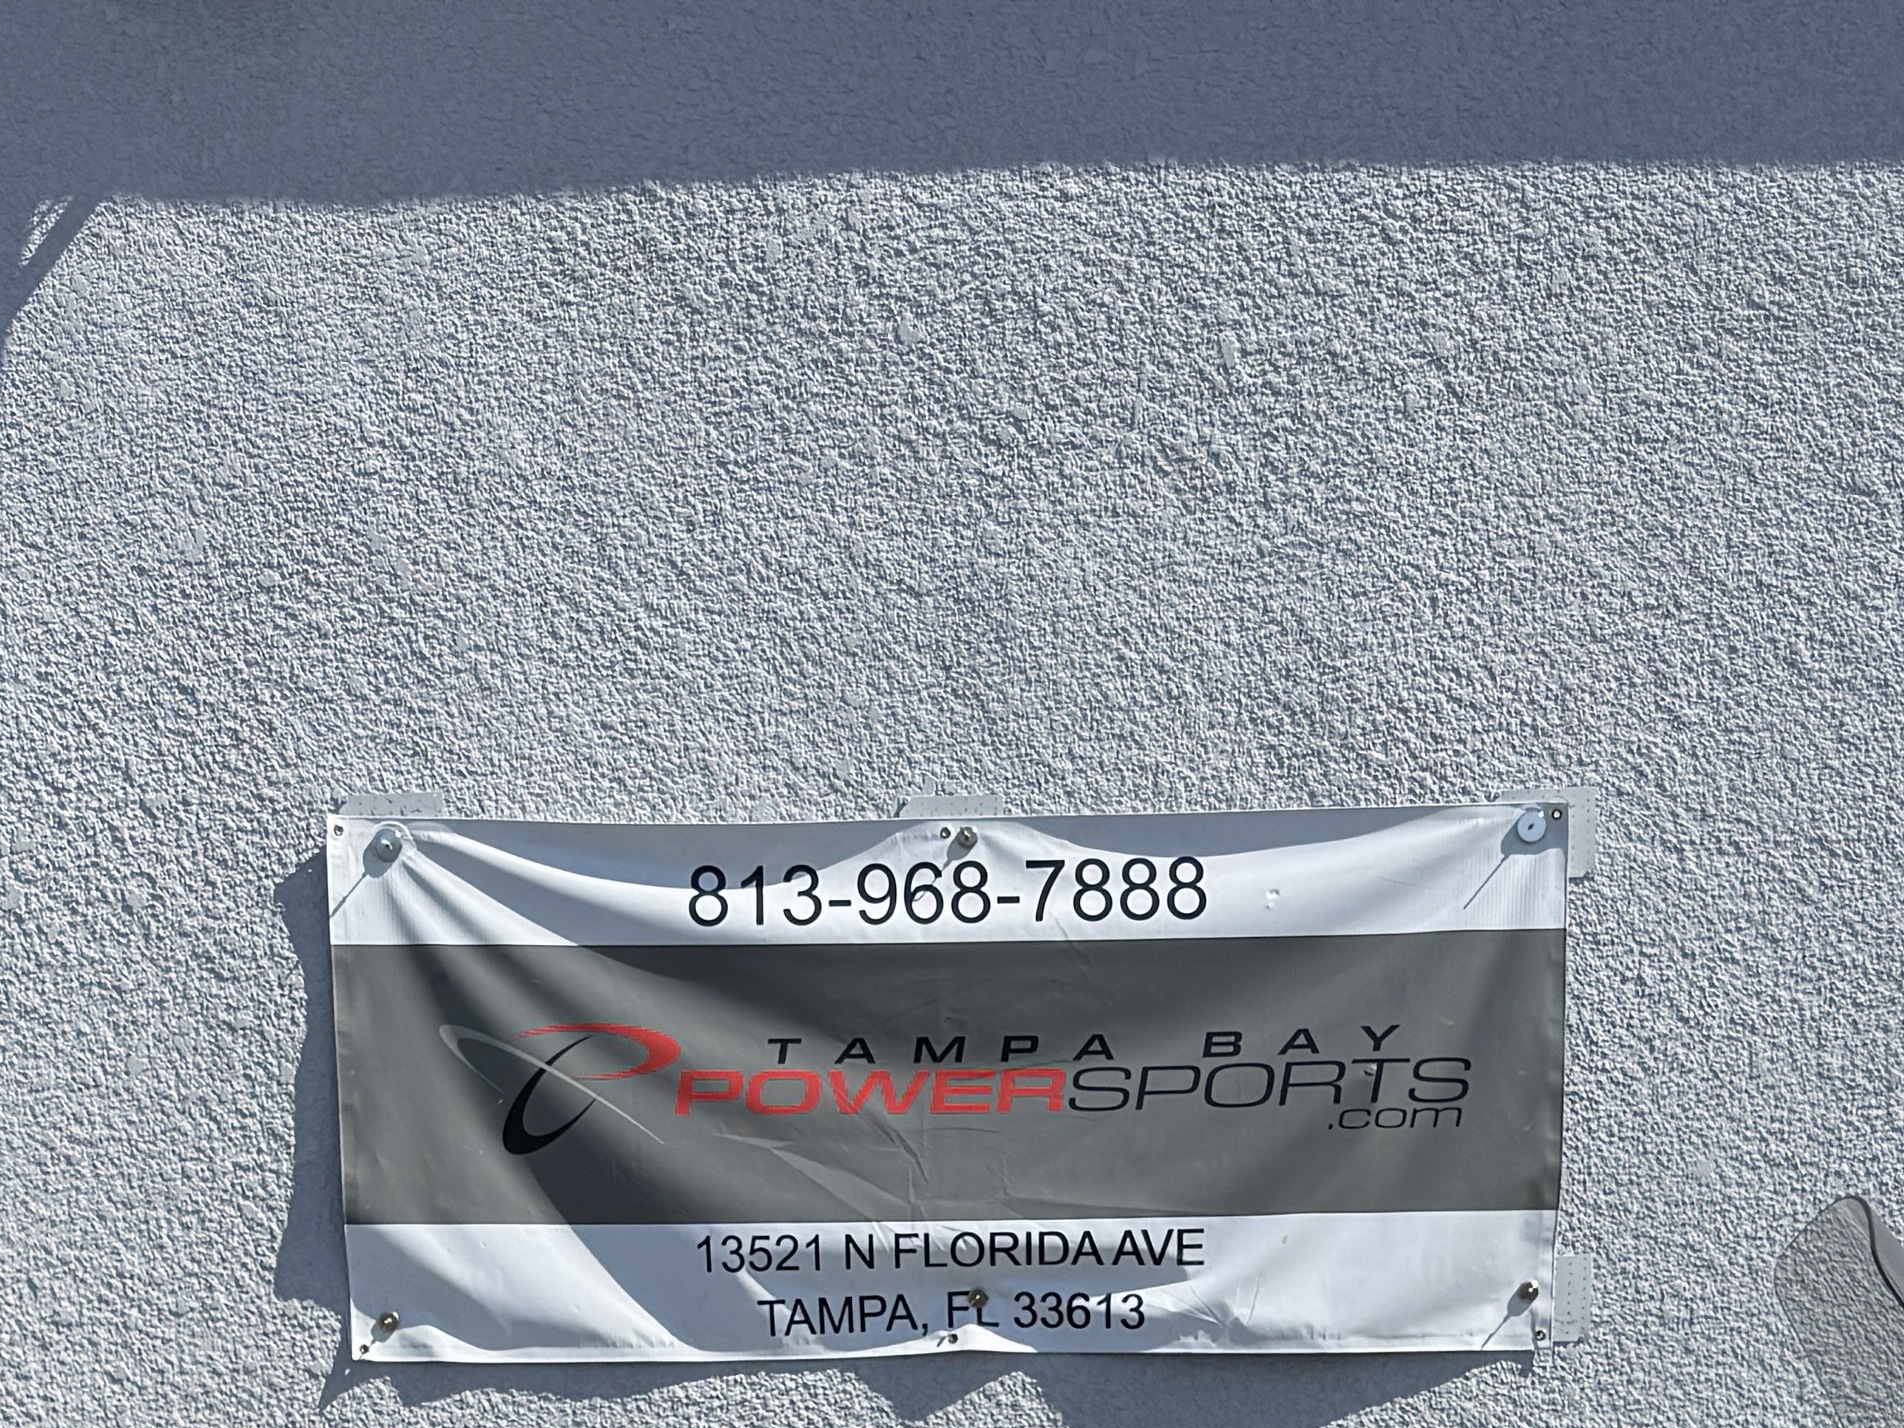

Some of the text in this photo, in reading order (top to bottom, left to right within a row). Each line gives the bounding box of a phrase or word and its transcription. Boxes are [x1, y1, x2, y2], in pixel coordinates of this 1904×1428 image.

[687, 855, 1208, 928] 813-968-7888
[767, 1024, 1400, 1065] TAMPA BAY
[674, 1057, 1472, 1116] POWERSPORTS
[1327, 1106, 1463, 1131] .com
[697, 1228, 1205, 1273] 13521 N FLORIDA AVE
[756, 1291, 1145, 1337] TAMPA, FL 33613
